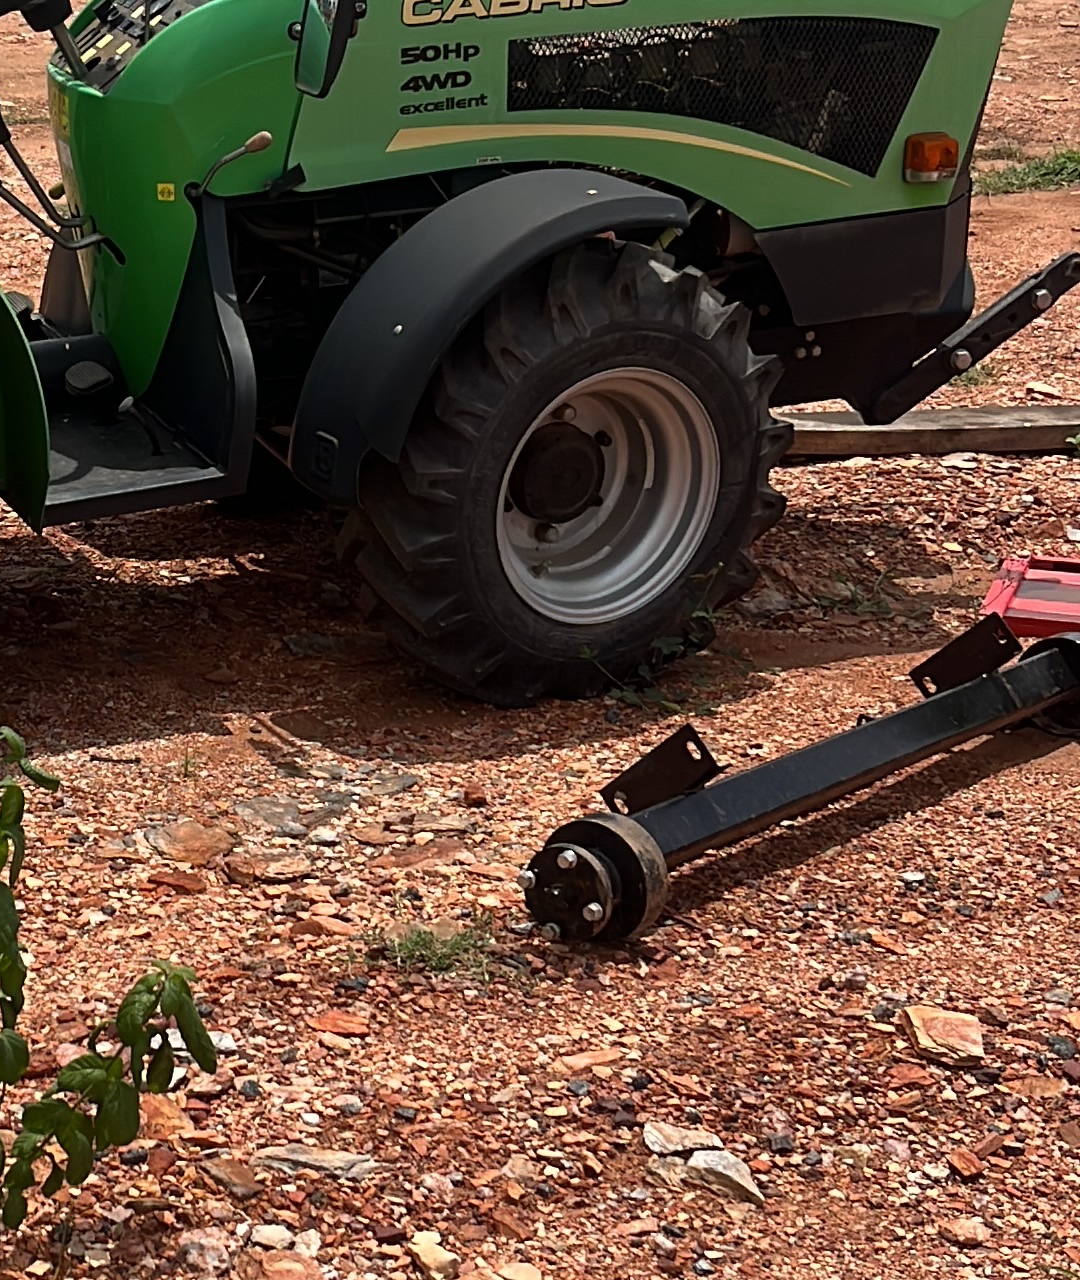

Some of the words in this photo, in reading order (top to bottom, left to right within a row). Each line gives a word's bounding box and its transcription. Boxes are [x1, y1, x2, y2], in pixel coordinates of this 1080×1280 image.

[400, 43, 480, 65] 50Hp
[400, 71, 472, 92] 4WD
[399, 93, 488, 115] excellent
